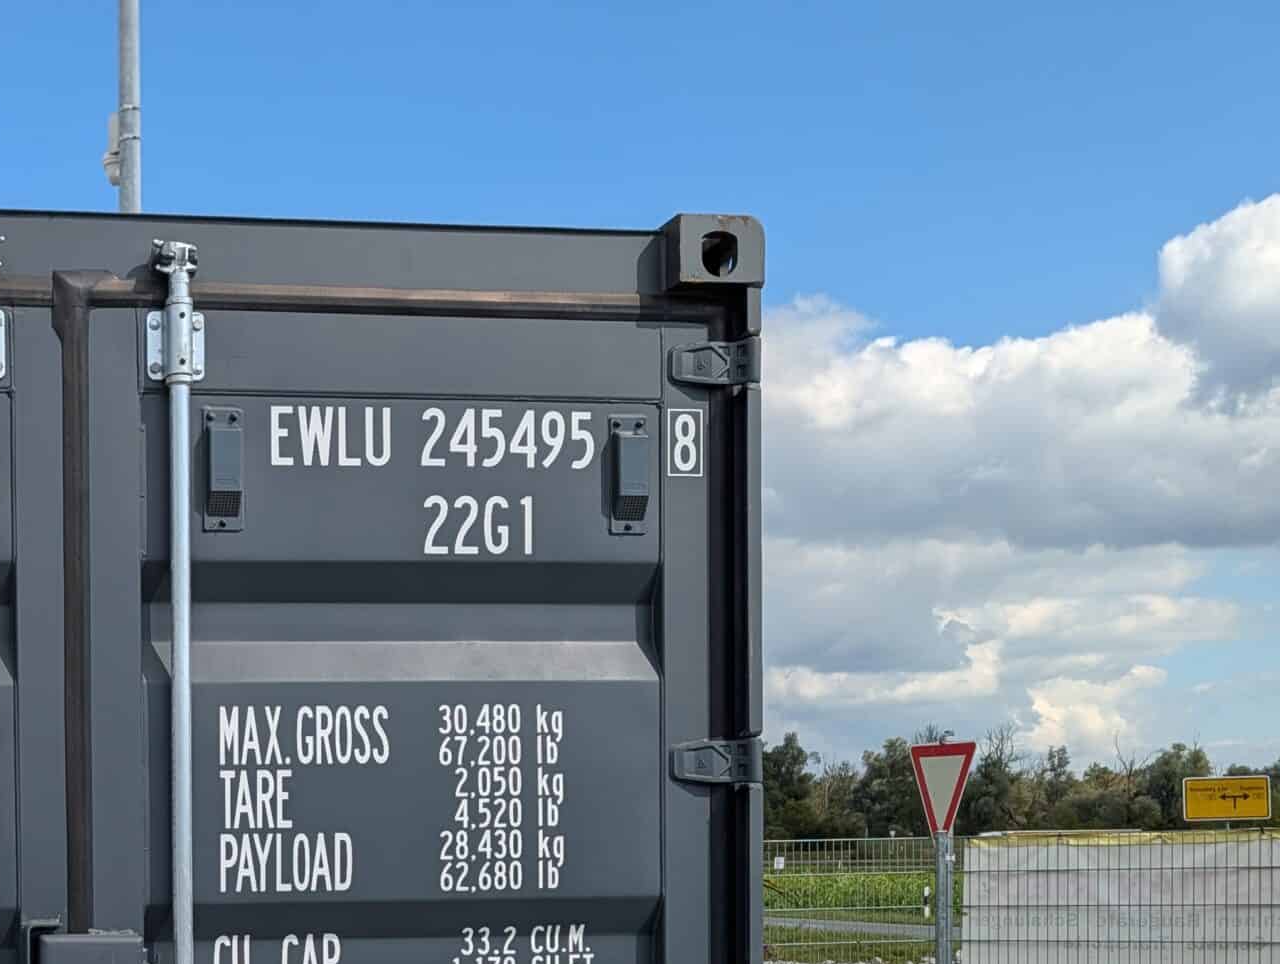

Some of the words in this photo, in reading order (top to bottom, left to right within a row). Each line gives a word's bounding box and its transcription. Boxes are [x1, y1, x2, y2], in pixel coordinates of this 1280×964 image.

[270, 405, 392, 467] EWLU
[420, 407, 595, 470] 245495
[673, 413, 698, 472] 8
[423, 494, 533, 555] 22G1
[438, 703, 521, 737] 30,480
[536, 704, 563, 742] kg
[438, 735, 522, 768] 67,200
[536, 735, 559, 764] lb
[219, 769, 293, 829] TARE
[454, 767, 522, 800] 2,050
[537, 767, 564, 805] kg
[454, 798, 522, 830] 4,520
[537, 798, 559, 827] lb
[219, 832, 354, 893] PAYLOAD
[439, 829, 523, 862] 28,430
[538, 831, 564, 868] kg
[439, 861, 523, 893] 62,680
[538, 861, 560, 889] lb
[460, 926, 518, 956] 33.2
[530, 924, 592, 955] CU.M.
